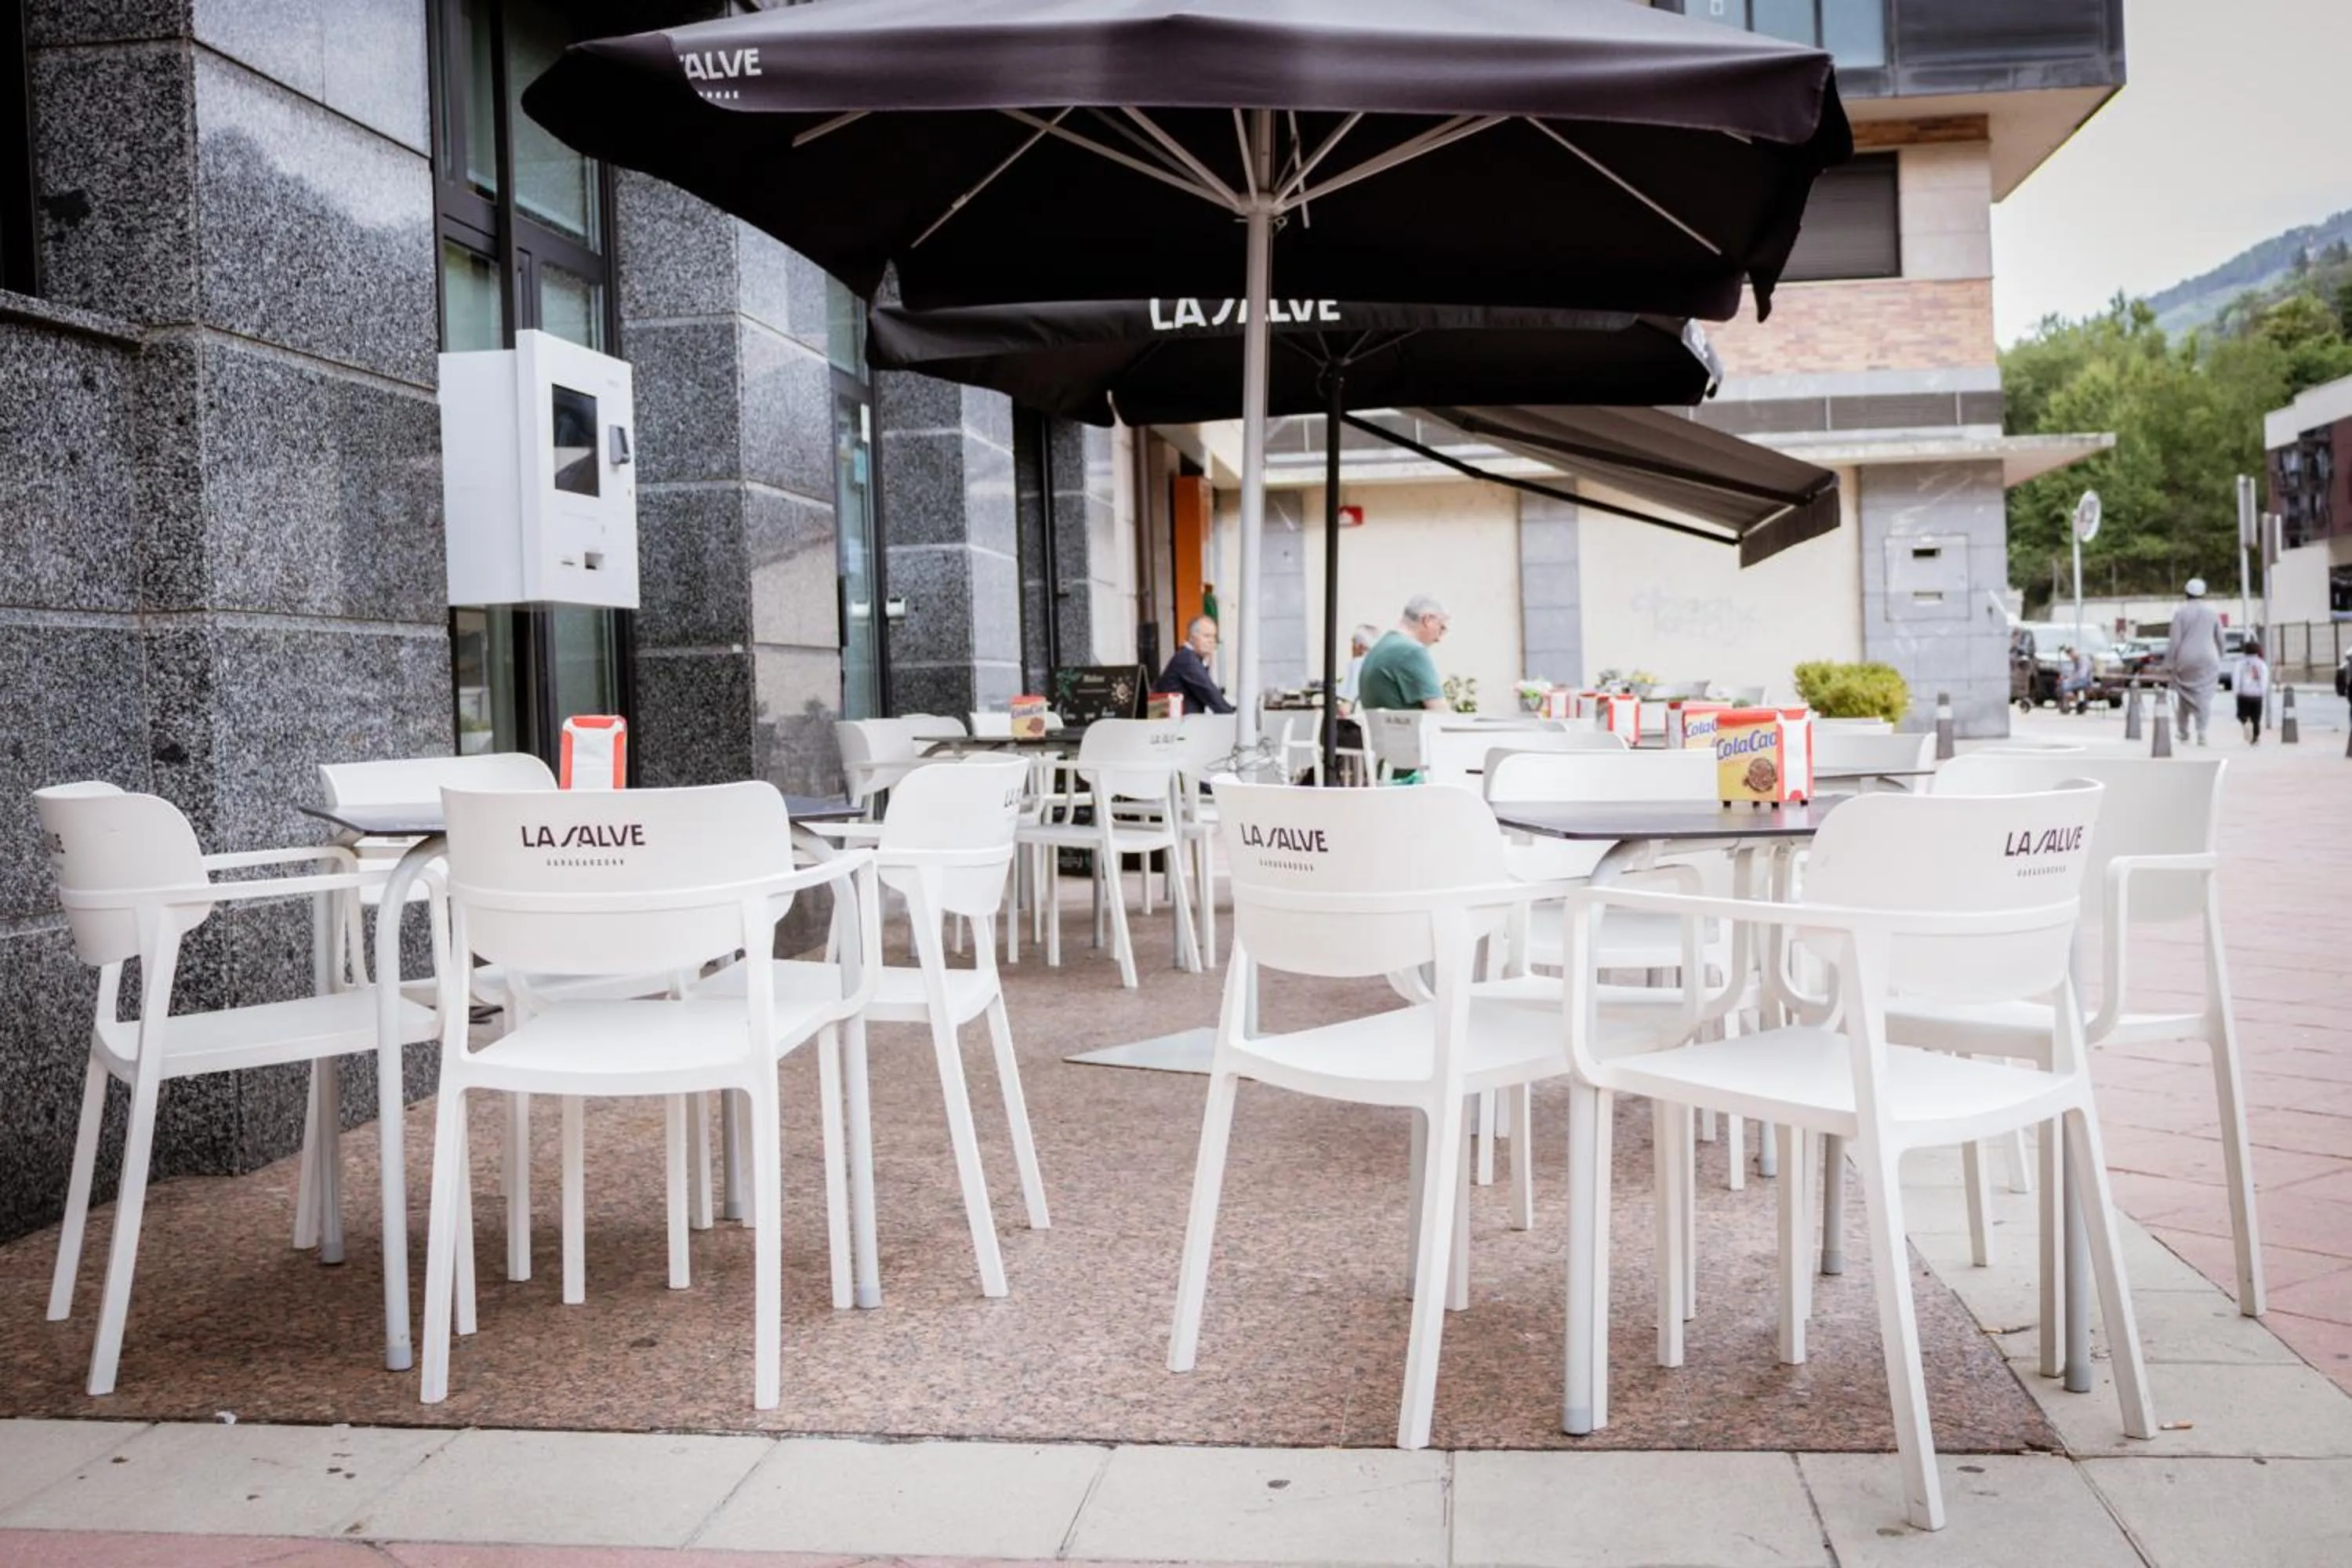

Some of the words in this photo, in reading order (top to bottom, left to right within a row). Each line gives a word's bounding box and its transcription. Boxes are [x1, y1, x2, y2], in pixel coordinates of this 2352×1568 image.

[678, 47, 762, 81] ALVE
[1149, 297, 1207, 331] LA
[521, 825, 556, 848] LA
[560, 823, 646, 848] SALVE
[1240, 822, 1265, 848] LA
[1266, 826, 1329, 853] SALVE
[2004, 830, 2031, 857] LA
[2032, 825, 2084, 855] SALVE
